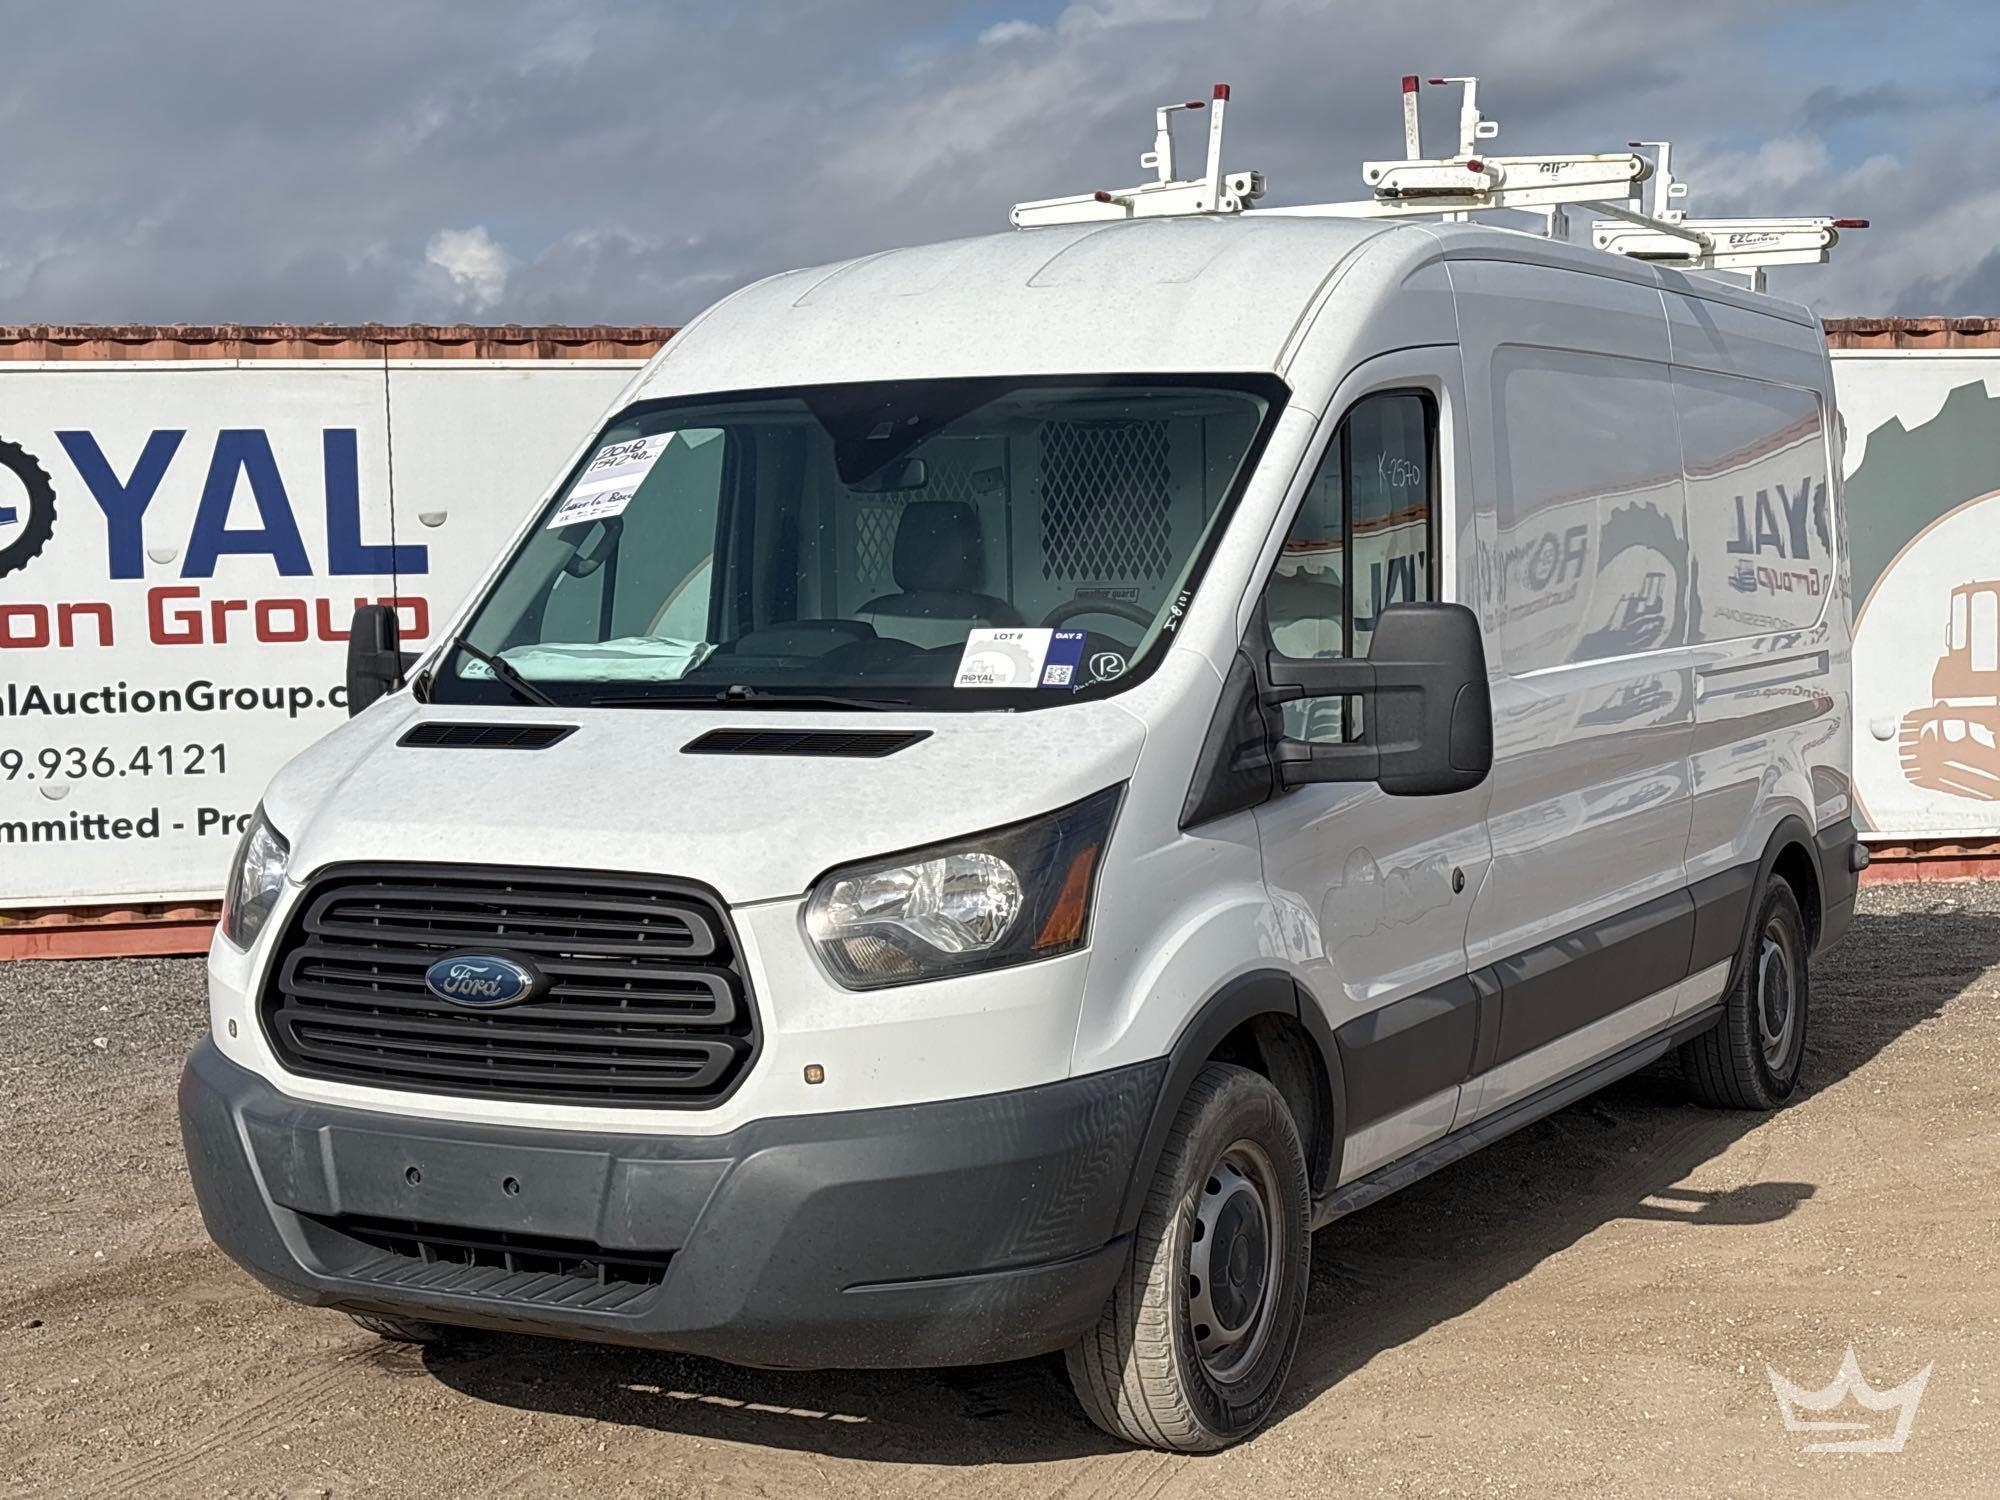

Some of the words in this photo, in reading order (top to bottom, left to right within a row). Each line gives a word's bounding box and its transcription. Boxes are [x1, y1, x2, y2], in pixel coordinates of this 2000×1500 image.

[1377, 450, 1420, 494] K-2570
[0, 602, 113, 648] on
[993, 633, 1016, 641] LOT
[1055, 632, 1075, 640] DAY
[0, 680, 348, 719] lAuctionGroup.c
[0, 743, 226, 780] 9.936.4121
[0, 808, 160, 843] mmitted
[443, 964, 502, 997] Ford
